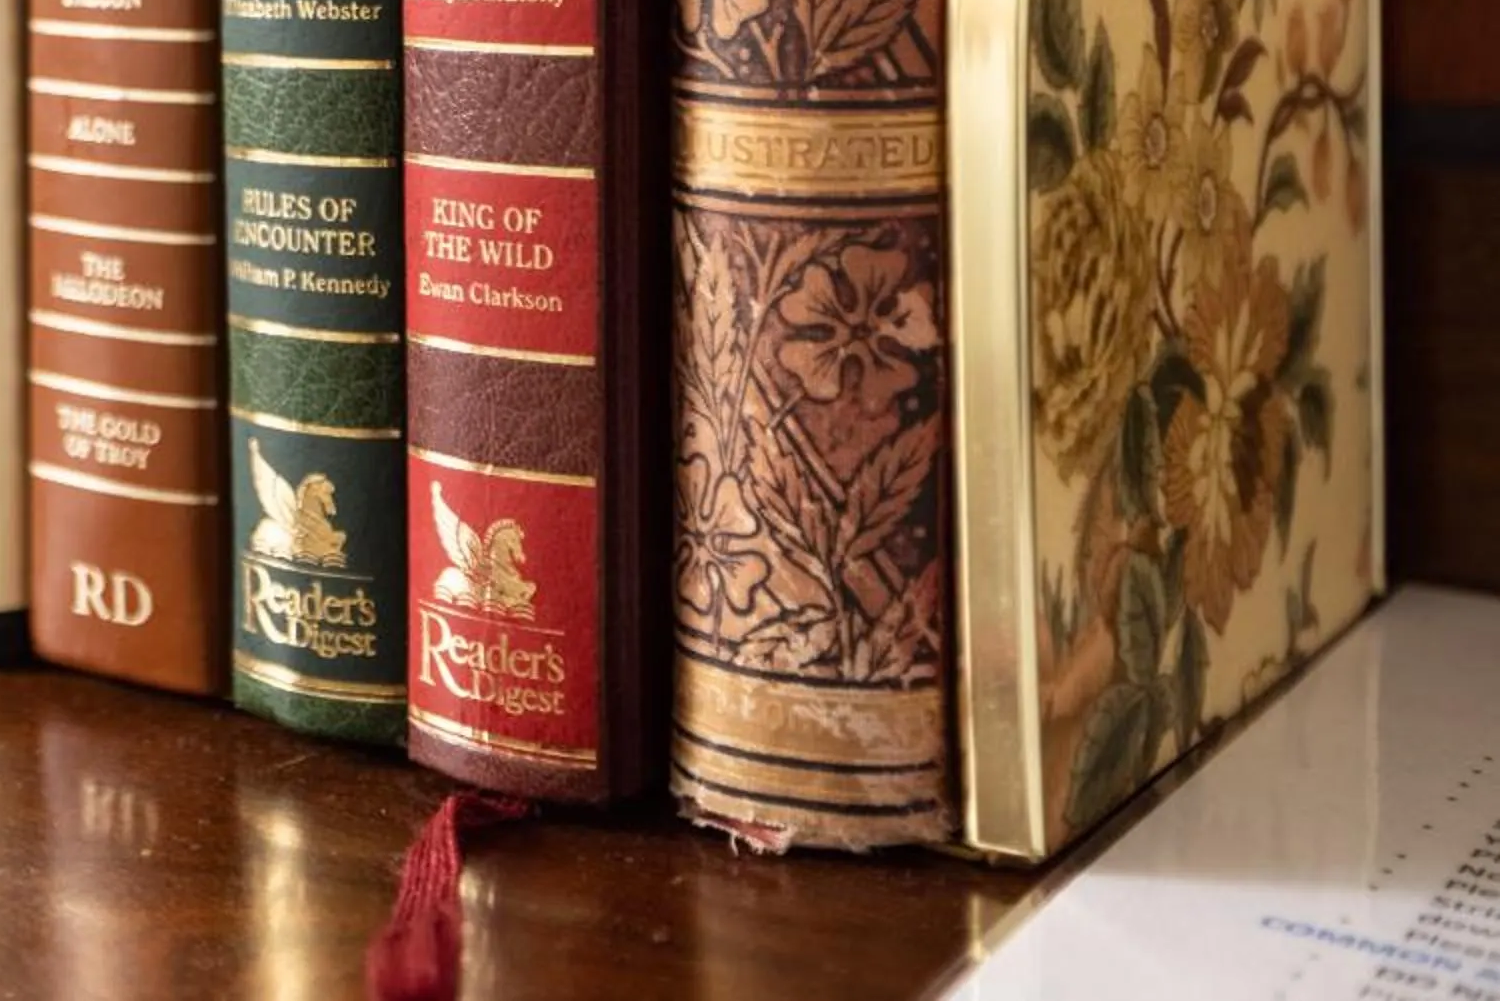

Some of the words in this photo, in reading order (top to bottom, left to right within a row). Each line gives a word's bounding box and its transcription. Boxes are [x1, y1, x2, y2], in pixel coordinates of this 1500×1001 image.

[66, 115, 137, 146] ALONE
[694, 133, 936, 171] USTRATED
[240, 188, 312, 220] RULES
[318, 196, 358, 223] OF
[432, 197, 495, 230] KING
[503, 206, 542, 235] OF
[234, 219, 376, 257] ENCOUNTER
[423, 230, 472, 264] THE
[478, 238, 554, 271] WILD
[80, 250, 126, 282] THE
[283, 266, 297, 291] P.
[300, 270, 391, 299] Kennedy
[418, 271, 466, 303] Ewan
[469, 281, 563, 312] Clarkson
[55, 402, 97, 433] THE
[99, 414, 162, 445] GOLD
[63, 434, 92, 459] OF
[93, 440, 152, 470] TROY
[70, 559, 154, 627] RD
[242, 563, 377, 646] Reader's
[285, 616, 377, 660] Digest
[417, 606, 566, 700] Reader's
[468, 668, 566, 715] Digest
